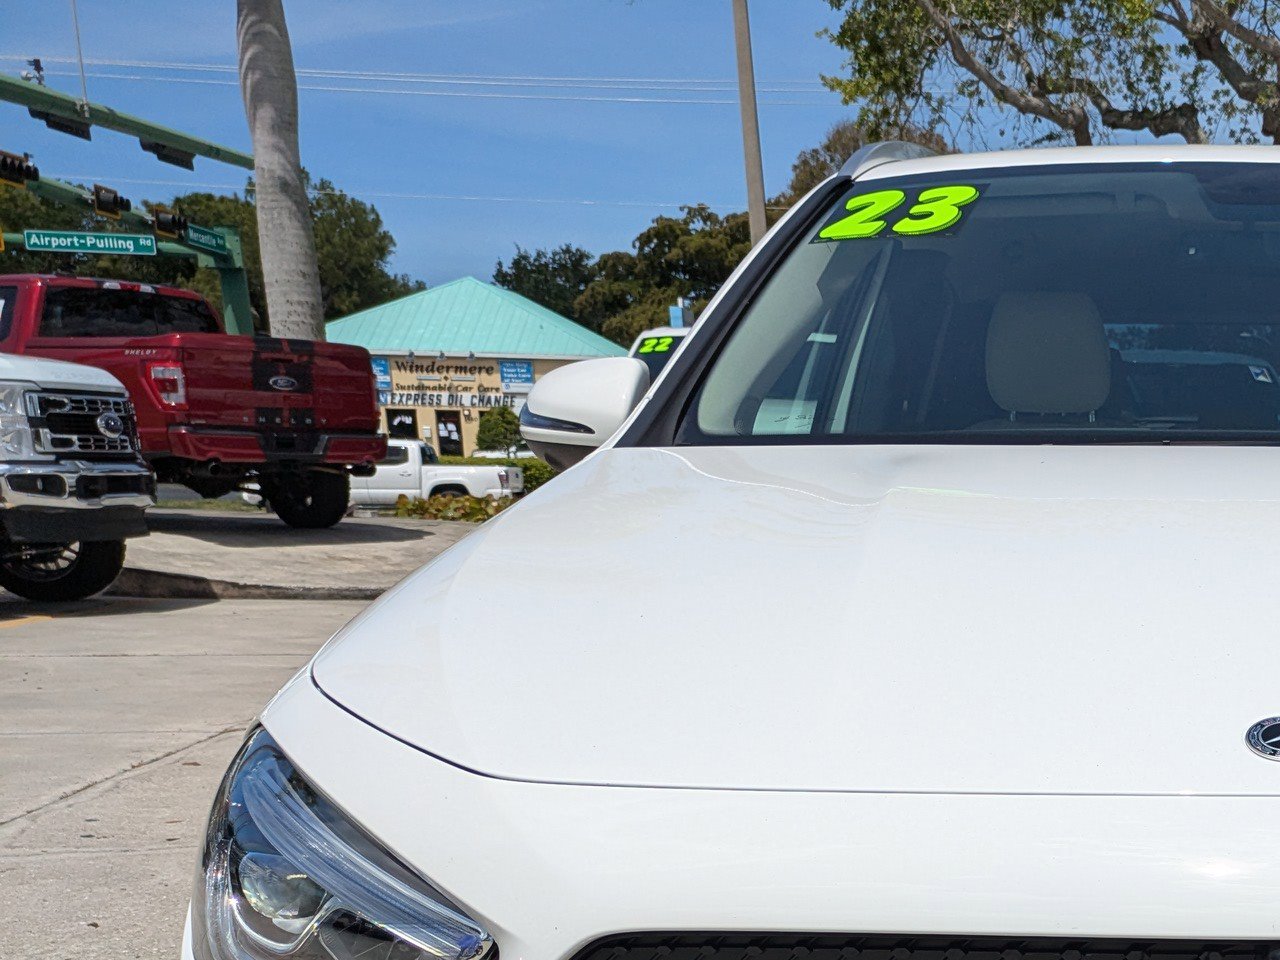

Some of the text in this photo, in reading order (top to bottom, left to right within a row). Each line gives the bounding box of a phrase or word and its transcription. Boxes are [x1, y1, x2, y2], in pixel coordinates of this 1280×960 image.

[819, 185, 980, 240] 23
[30, 234, 151, 252] Airport-Pulling Rd
[638, 337, 674, 354] 22
[395, 360, 495, 375] Windermere
[395, 383, 501, 393] Sustainable Car Care
[390, 392, 442, 406] EXPRESS
[447, 394, 465, 407] OIL
[470, 394, 517, 408] CHANGE
